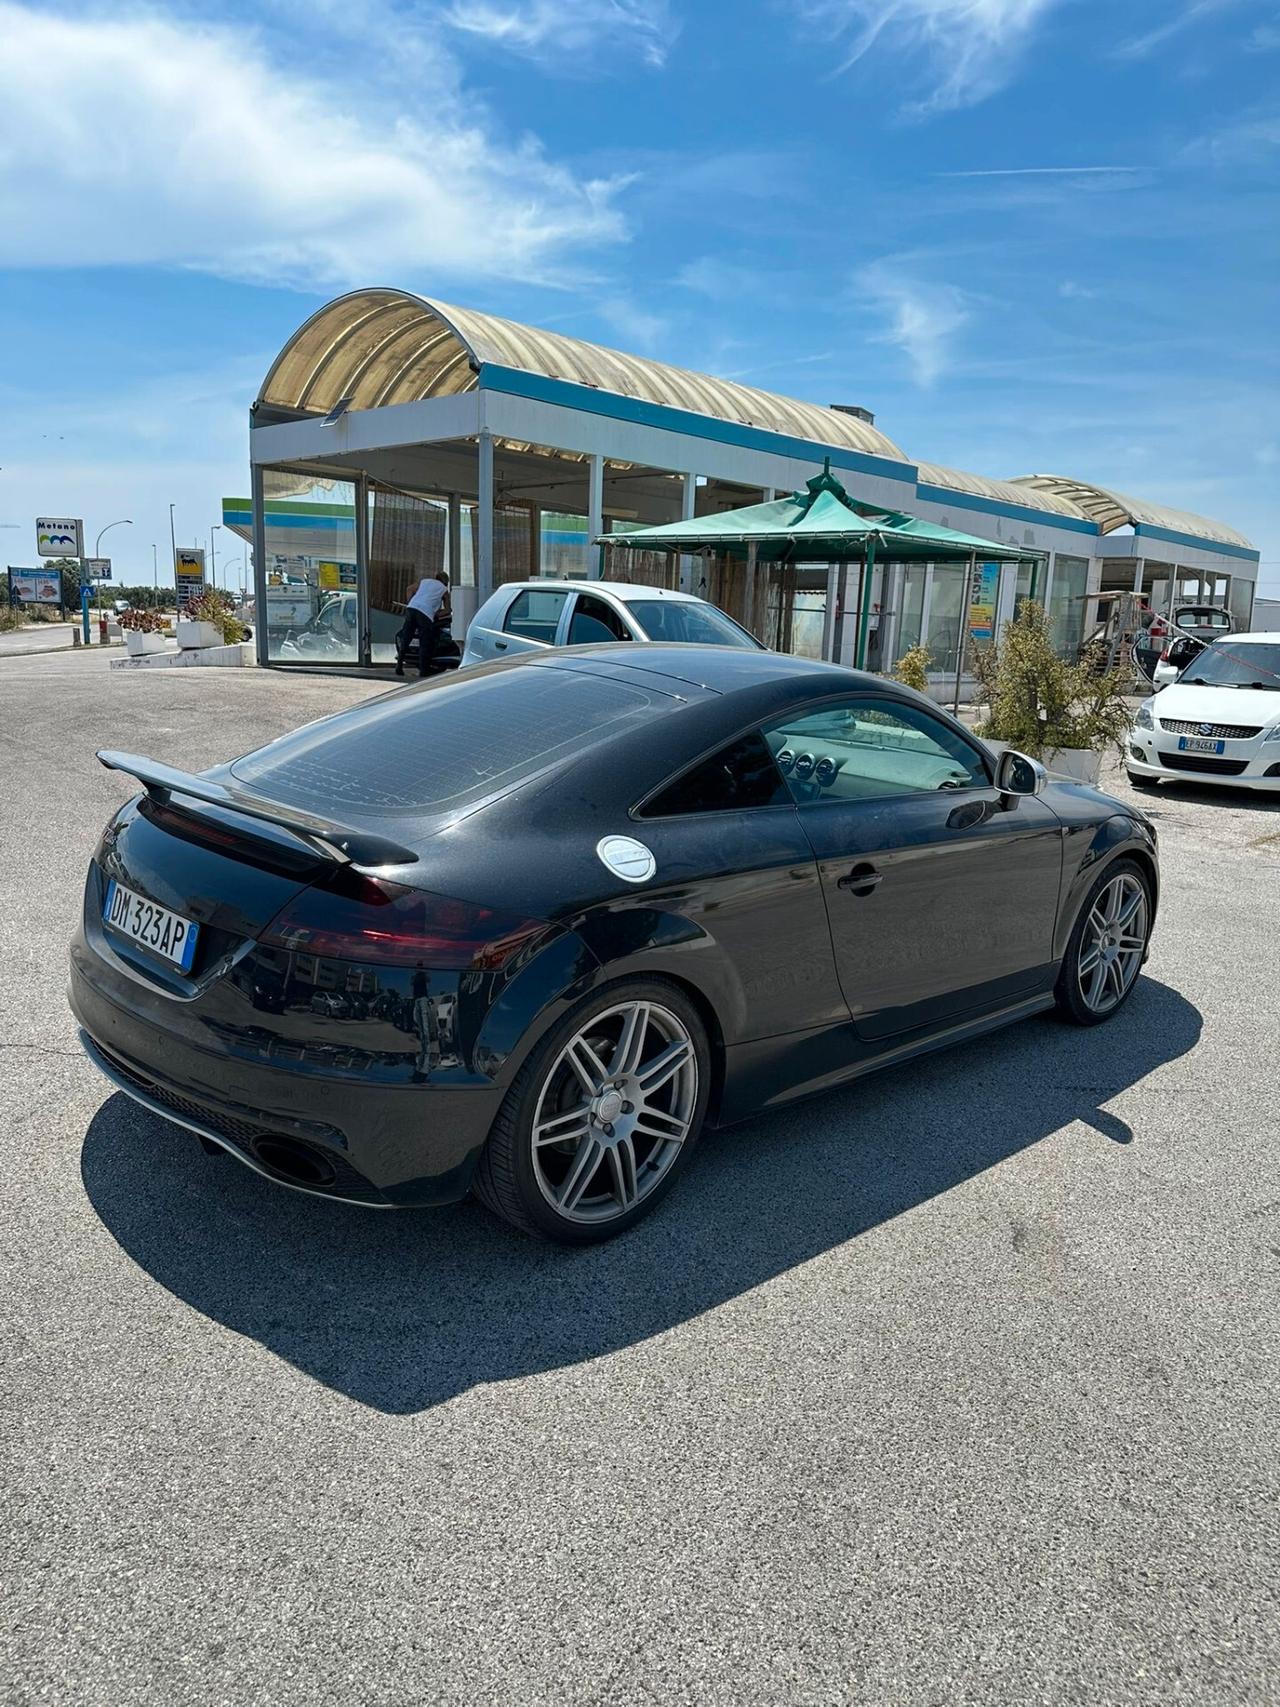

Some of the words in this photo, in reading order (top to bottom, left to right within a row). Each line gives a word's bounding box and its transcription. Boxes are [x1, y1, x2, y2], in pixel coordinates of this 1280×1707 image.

[38, 522, 75, 530] Metano
[111, 887, 132, 929] DM
[132, 900, 184, 956] 323AP
